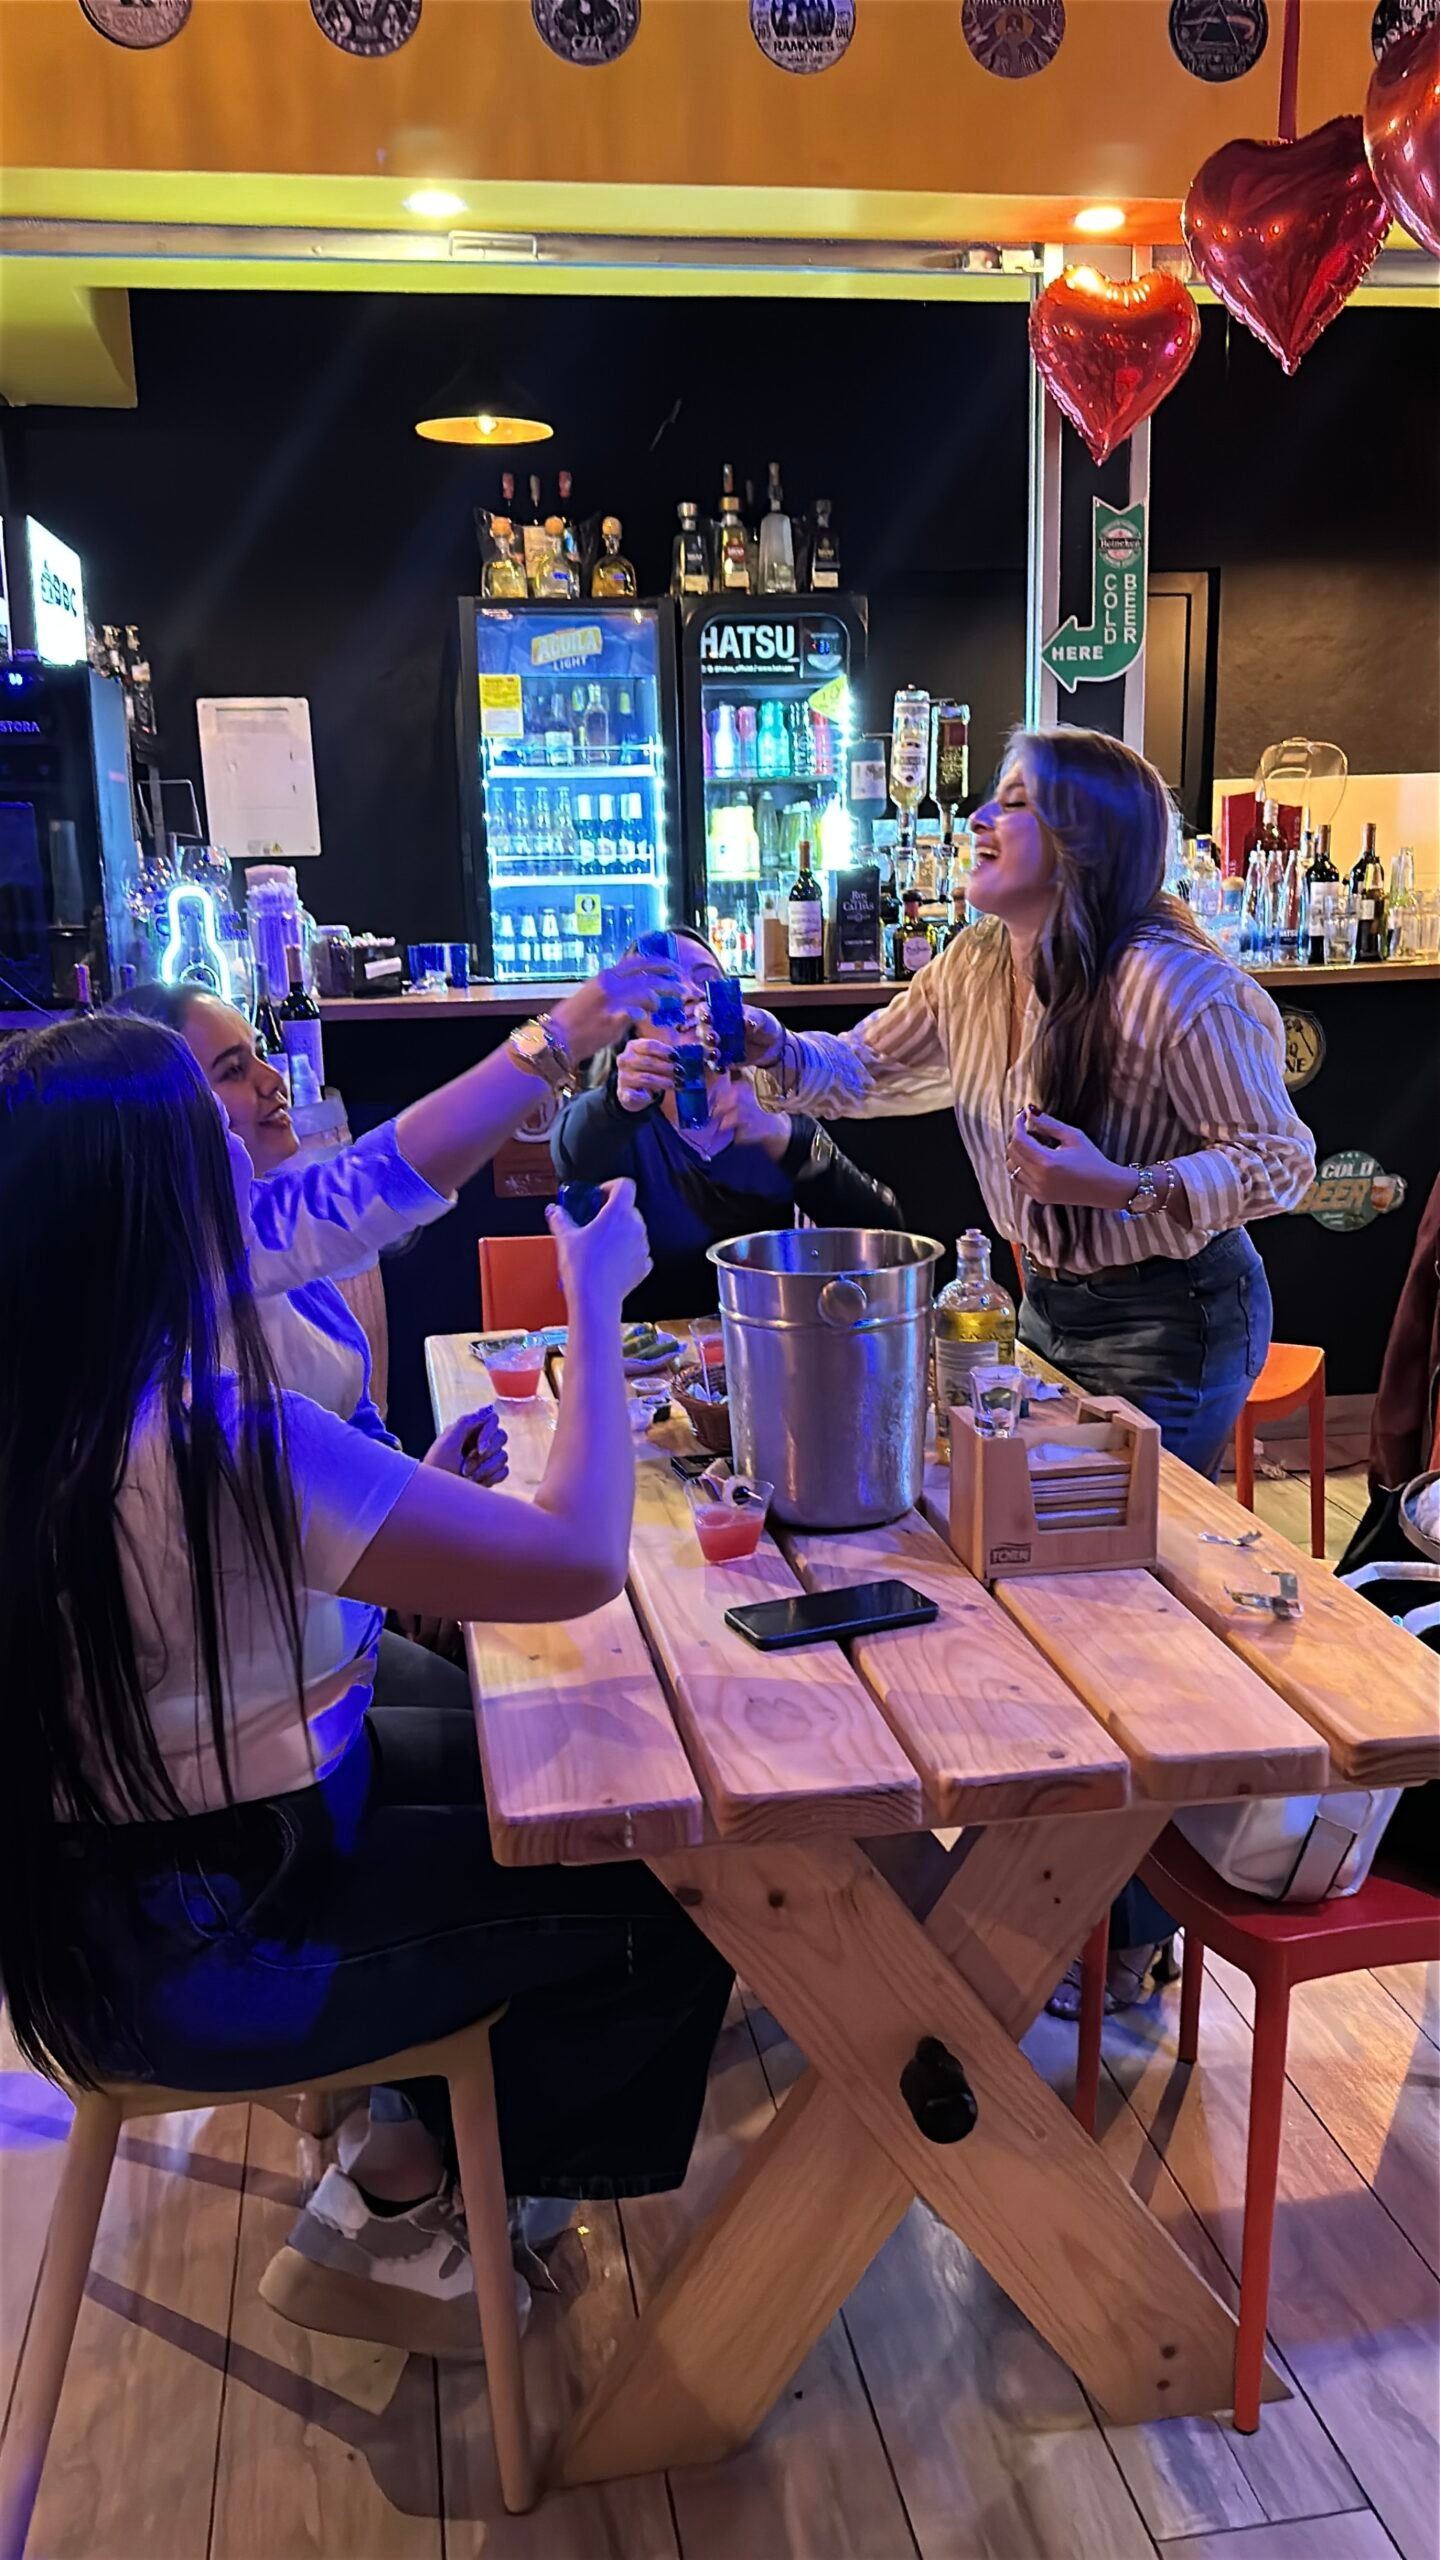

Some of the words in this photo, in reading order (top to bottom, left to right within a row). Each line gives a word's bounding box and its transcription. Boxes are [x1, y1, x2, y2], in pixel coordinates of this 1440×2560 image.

[1104, 573, 1118, 645] COLD
[1124, 573, 1137, 645] BEER
[701, 624, 795, 660] HATSU
[1052, 645, 1104, 661] HERE
[553, 654, 588, 672] LIGHT
[1321, 1159, 1374, 1179] COLD
